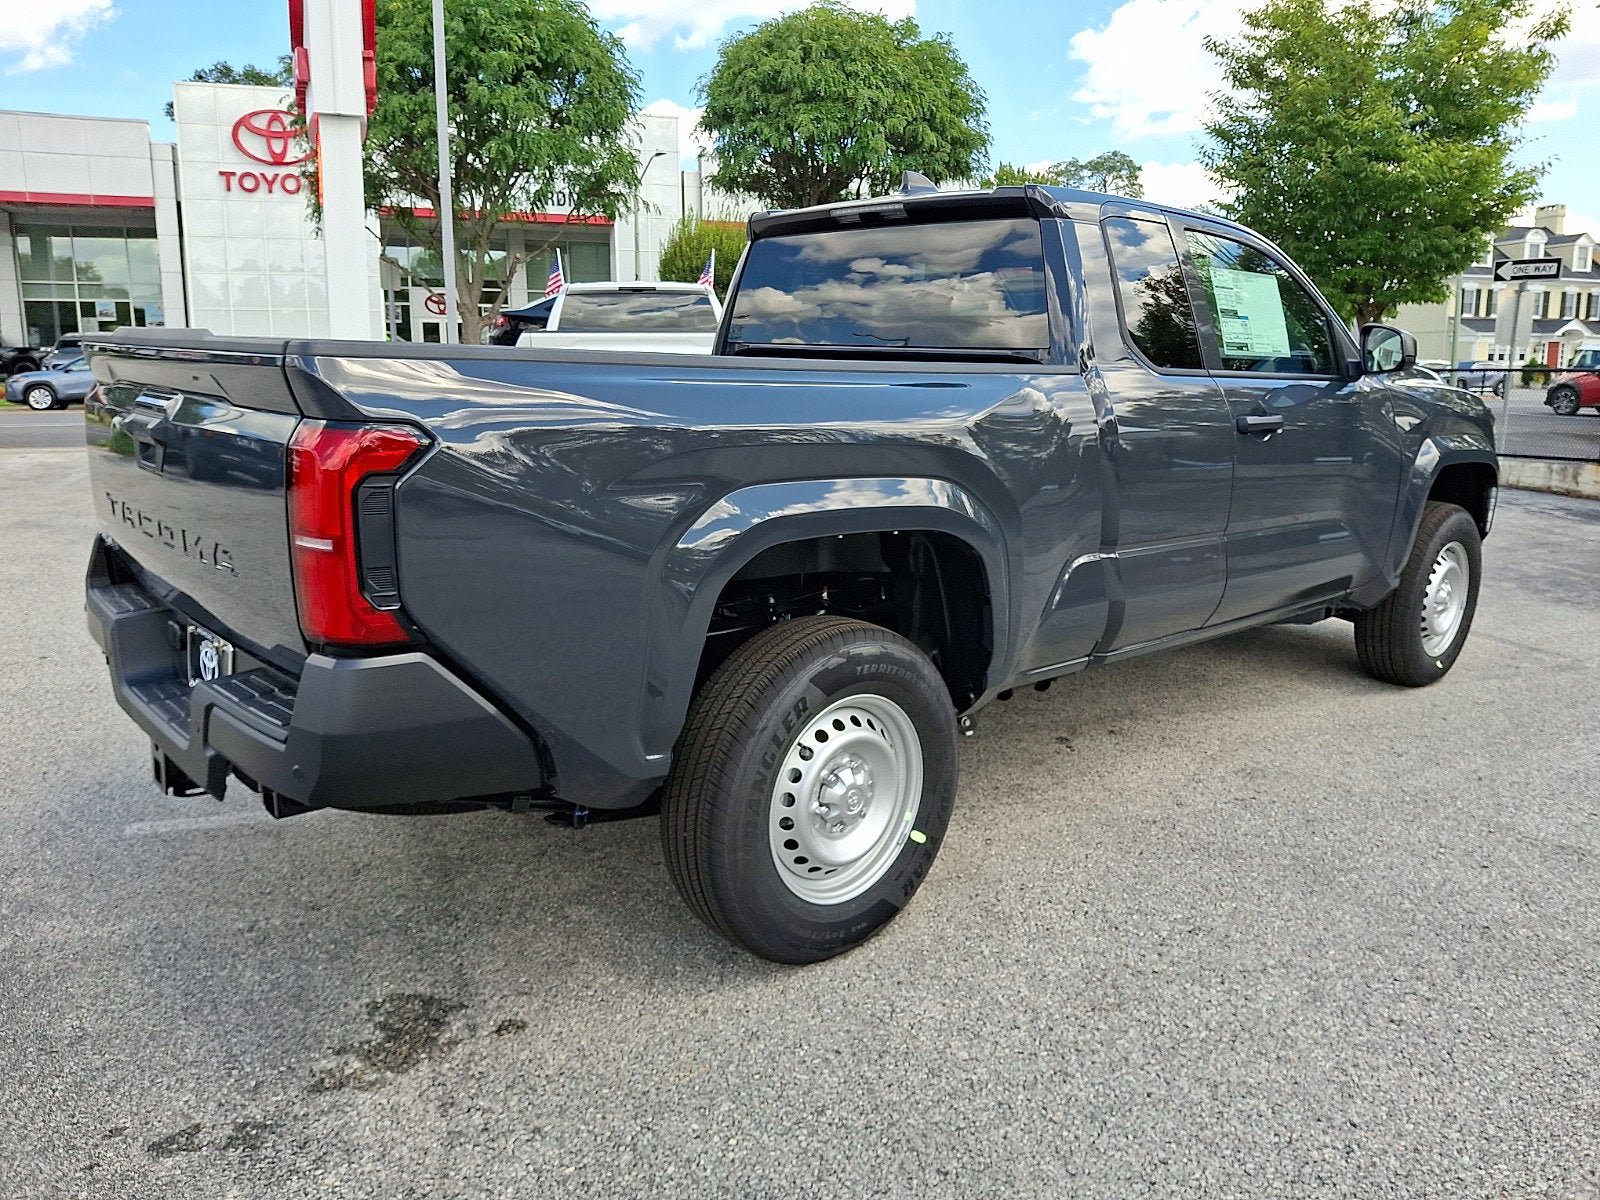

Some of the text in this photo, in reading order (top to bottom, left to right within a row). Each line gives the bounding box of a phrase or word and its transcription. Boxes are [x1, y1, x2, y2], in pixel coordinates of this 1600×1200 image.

[218, 171, 303, 195] TOYO
[1512, 264, 1555, 275] ONE WAY
[106, 491, 241, 578] TACOMA
